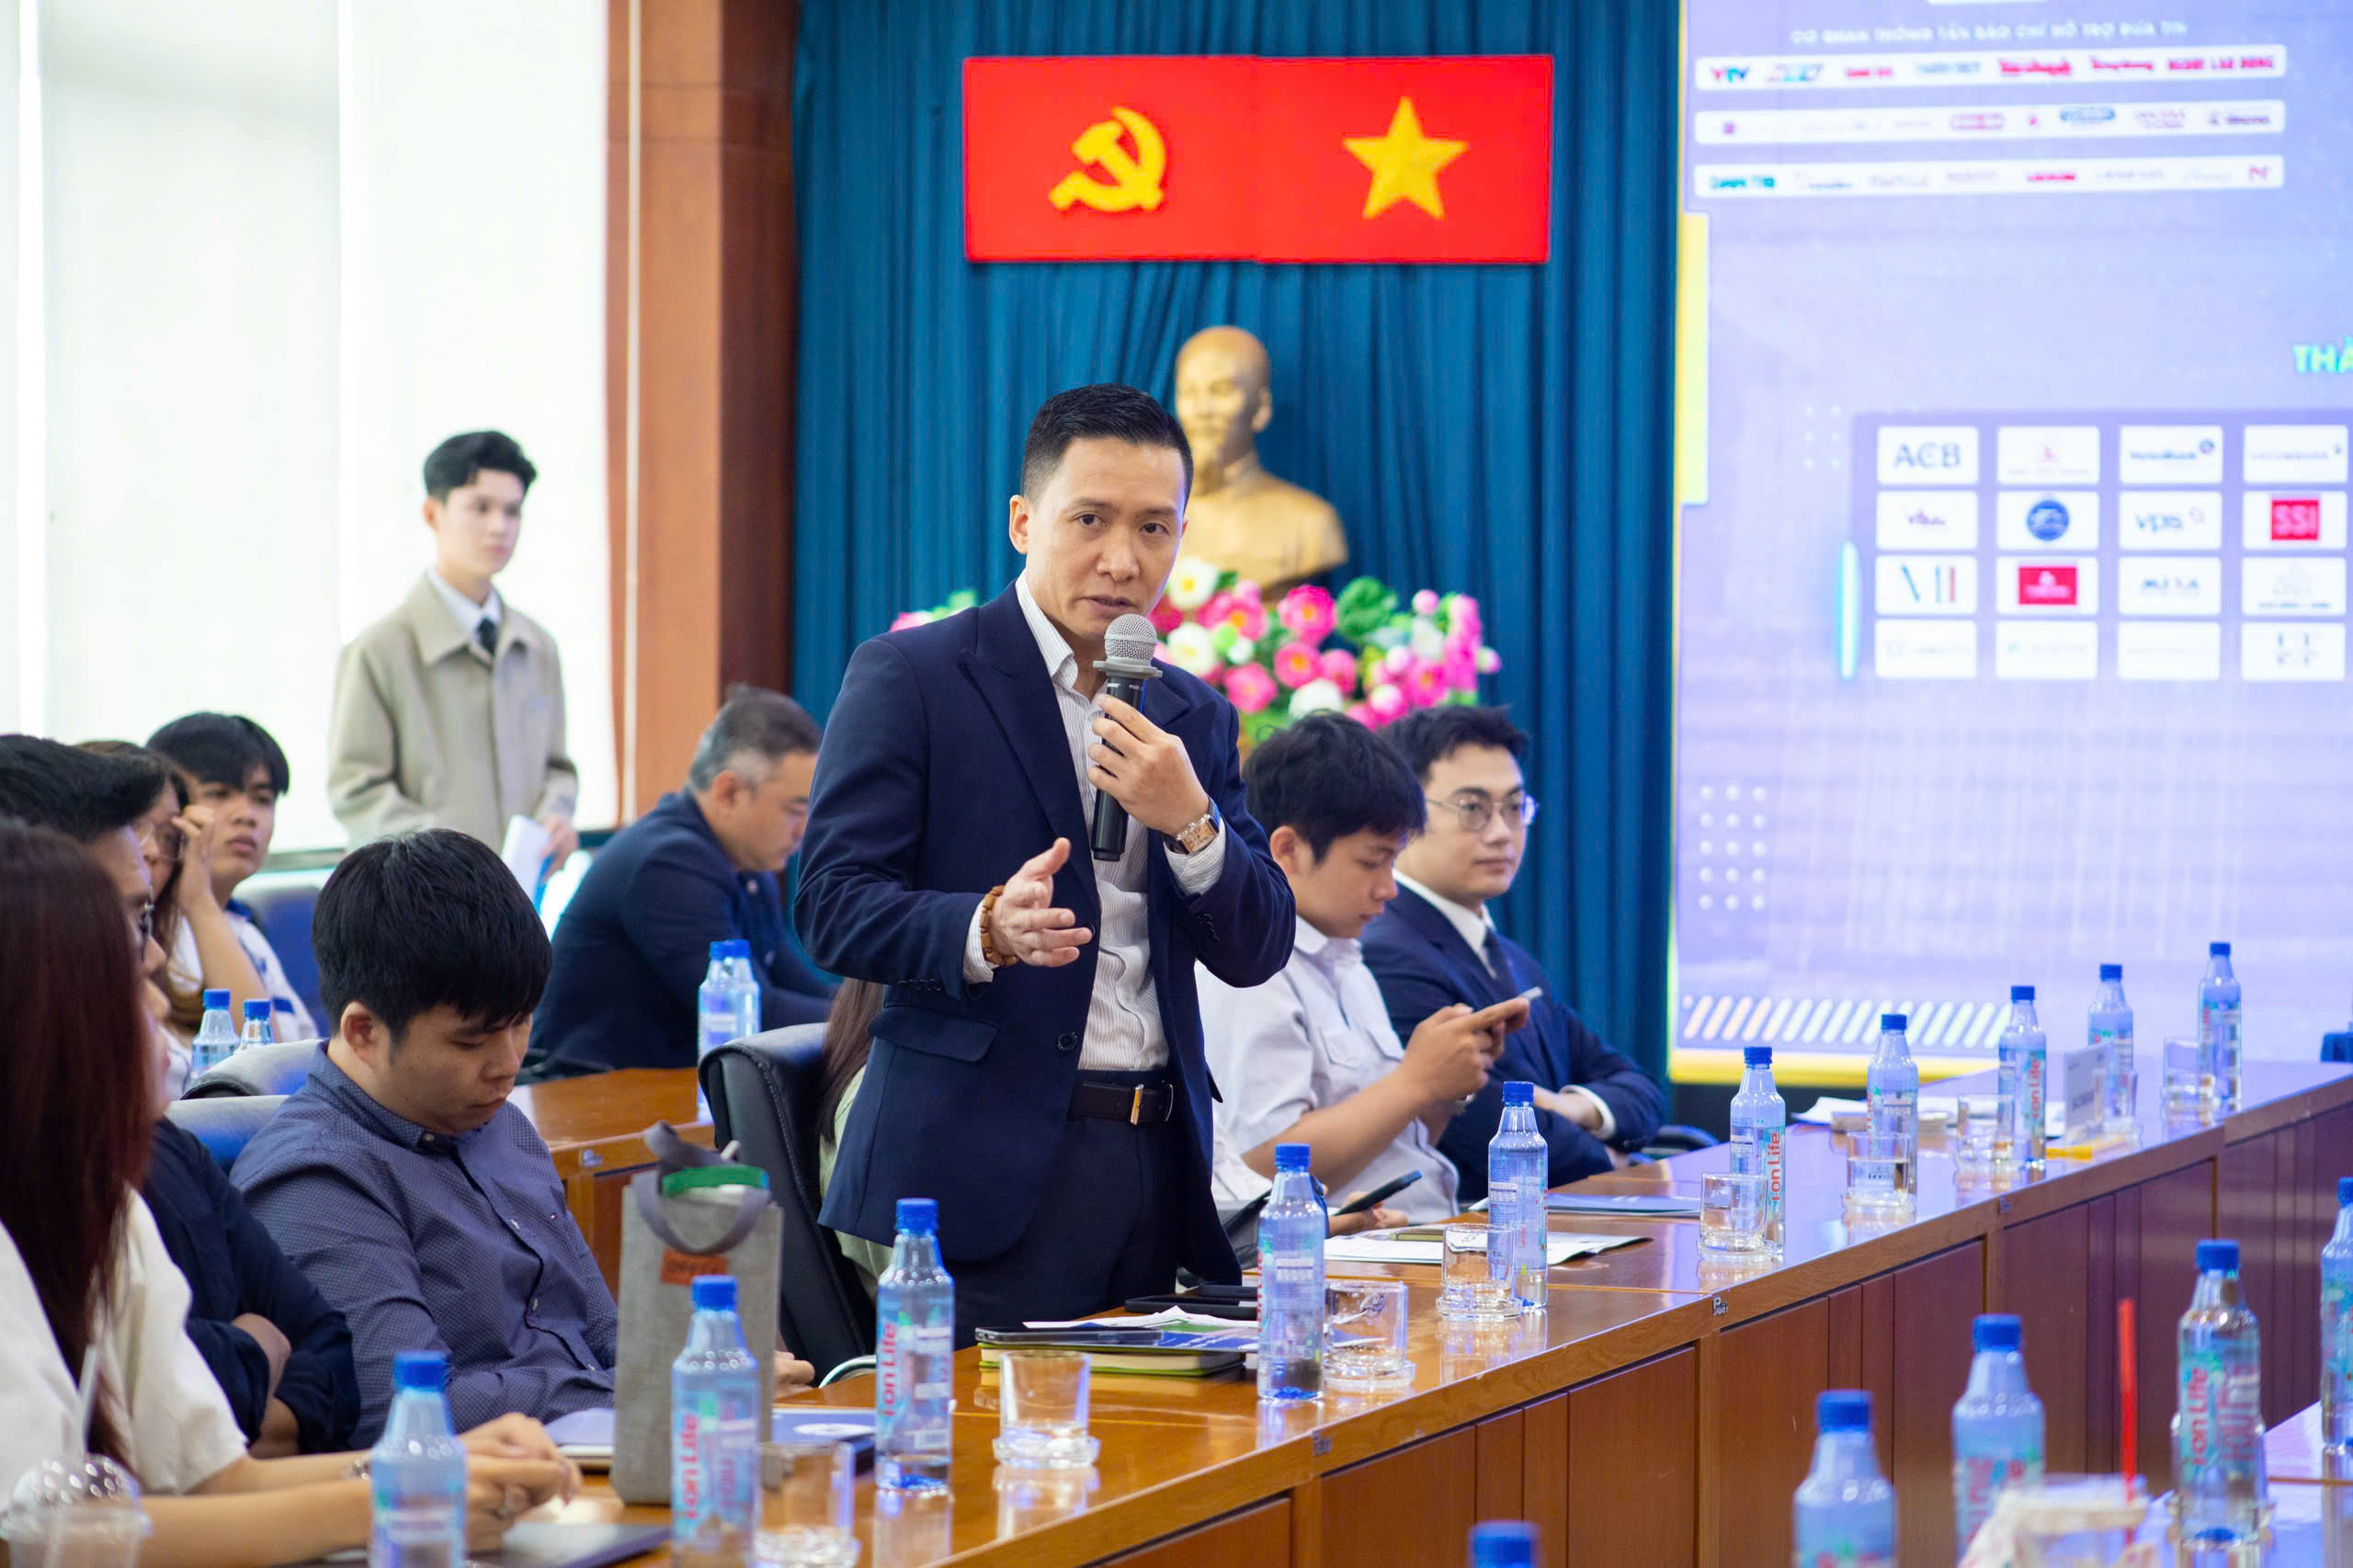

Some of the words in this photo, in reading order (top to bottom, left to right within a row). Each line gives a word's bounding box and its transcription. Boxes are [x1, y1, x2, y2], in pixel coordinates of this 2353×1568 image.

[1893, 442, 1961, 468] ACB
[2274, 506, 2317, 536] SSI
[1767, 1132, 1780, 1165] Life
